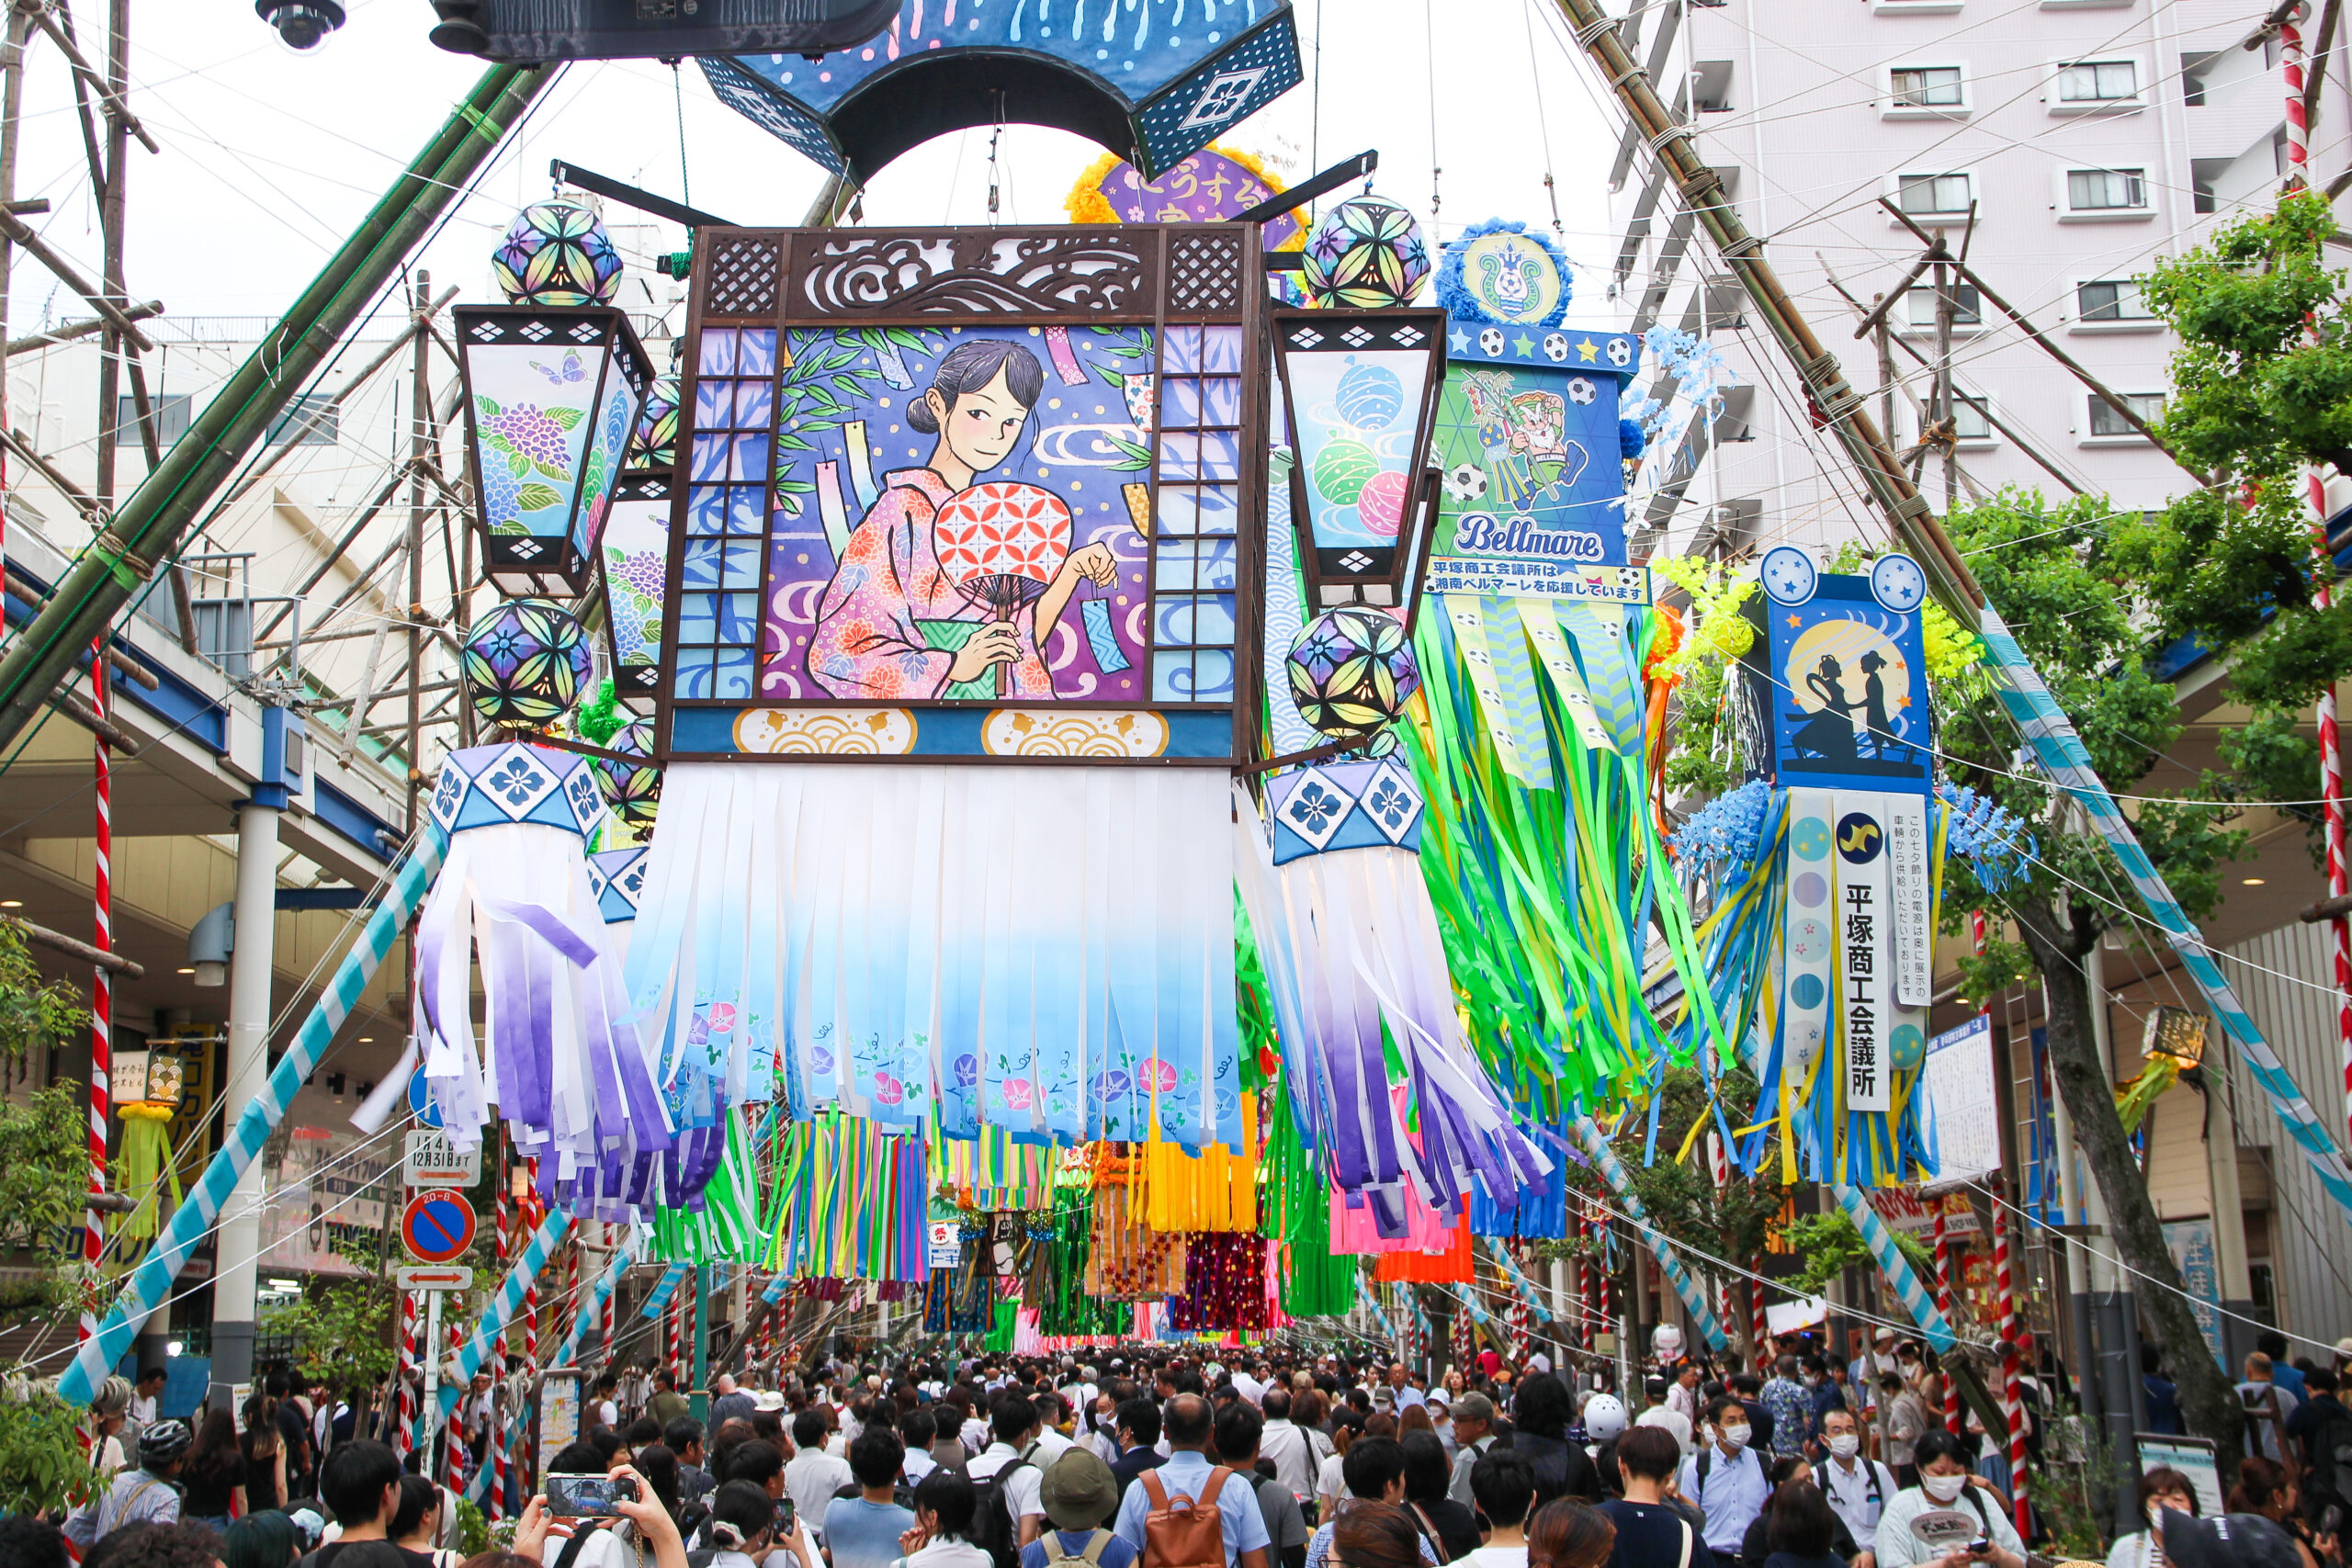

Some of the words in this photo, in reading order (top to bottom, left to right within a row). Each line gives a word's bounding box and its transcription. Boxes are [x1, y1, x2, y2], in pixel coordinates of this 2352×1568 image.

[1456, 513, 1603, 558] Bellmare
[1433, 561, 1558, 578] 平塚商工会議所は
[1434, 576, 1643, 601] 湘南ベルマーレを応援しています
[1909, 815, 1927, 998] この七夕飾りの電源は奥に展示の
[1846, 884, 1876, 1099] 平塚商工会議所
[413, 1152, 471, 1168] 12月31日まで
[423, 1192, 451, 1204] 20-8
